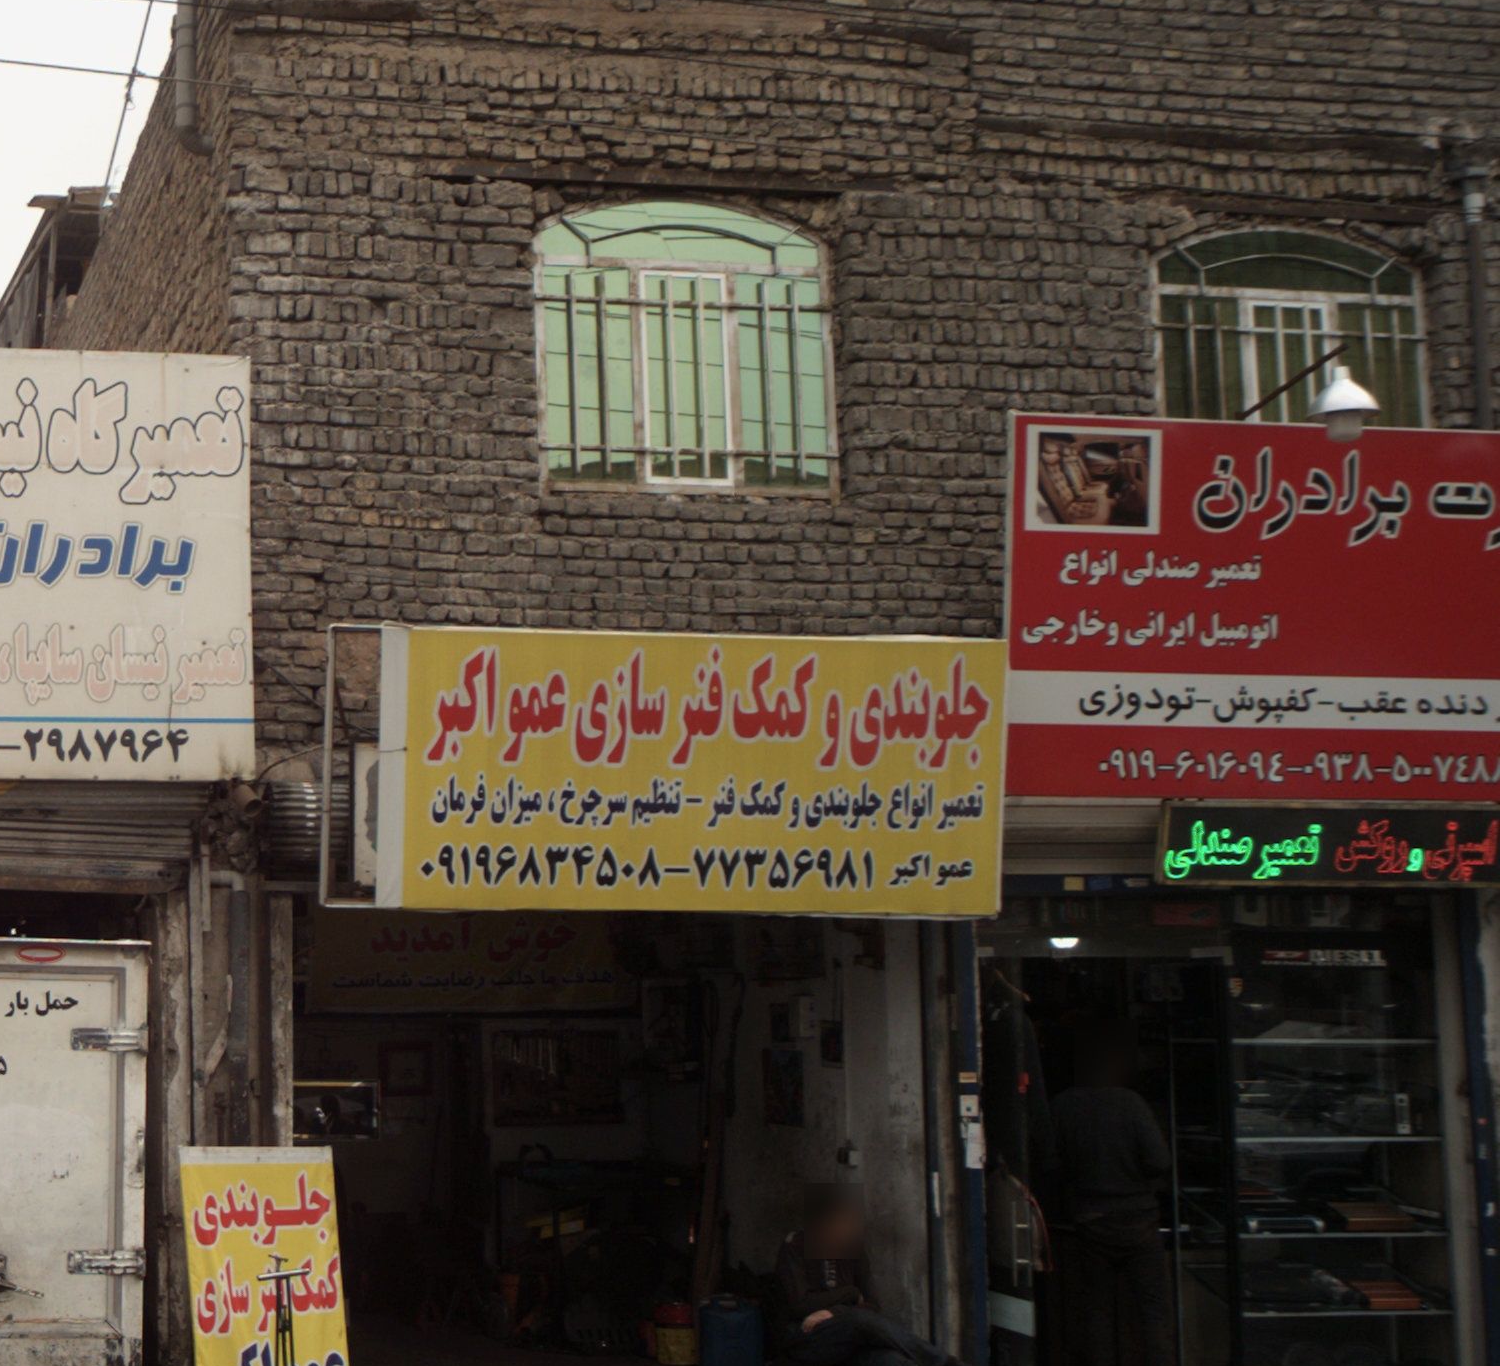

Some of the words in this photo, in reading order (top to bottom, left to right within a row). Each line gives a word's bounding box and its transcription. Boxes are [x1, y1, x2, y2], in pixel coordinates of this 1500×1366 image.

[1192, 446, 1411, 547] برادران
[1059, 548, 1118, 585] انواع
[1121, 550, 1200, 587] صندلی
[1205, 556, 1262, 588] تعمیر
[1123, 611, 1196, 647] ایرانی
[1200, 614, 1279, 648] اتومبیل
[86, 623, 169, 703] نیسان
[172, 628, 246, 704] تعمیر
[425, 646, 499, 763] اکبر
[502, 672, 568, 765] عمو
[574, 649, 666, 764] سازی
[671, 646, 723, 766] فنر
[732, 653, 818, 740] کمک
[849, 654, 991, 769] جلوبندی
[1417, 693, 1488, 716] دنده
[819, 692, 844, 769] و
[430, 773, 487, 824] فرمان
[490, 777, 542, 825] میزان
[630, 775, 681, 827] تنظیم
[708, 777, 735, 830] فنر
[740, 780, 786, 818] کمک
[792, 801, 801, 828] و
[804, 780, 882, 830] جلوبندی
[886, 782, 933, 826] انواع
[937, 782, 985, 830] تعمیر
[889, 852, 931, 886] اکبر
[1163, 819, 1253, 880] صندلی
[1252, 823, 1323, 880] تعمیر
[1334, 819, 1407, 873] روکش
[1405, 847, 1424, 873] و
[936, 856, 974, 887] عمو
[371, 912, 470, 962] آمدید
[486, 914, 577, 962] خوش
[333, 970, 412, 989] شماست
[419, 969, 484, 989] رضایت
[562, 965, 616, 985] هدف
[5, 991, 30, 1017] بار
[35, 993, 79, 1015] حمل
[193, 1172, 331, 1246] جلوبندی
[197, 1259, 250, 1334] سازی
